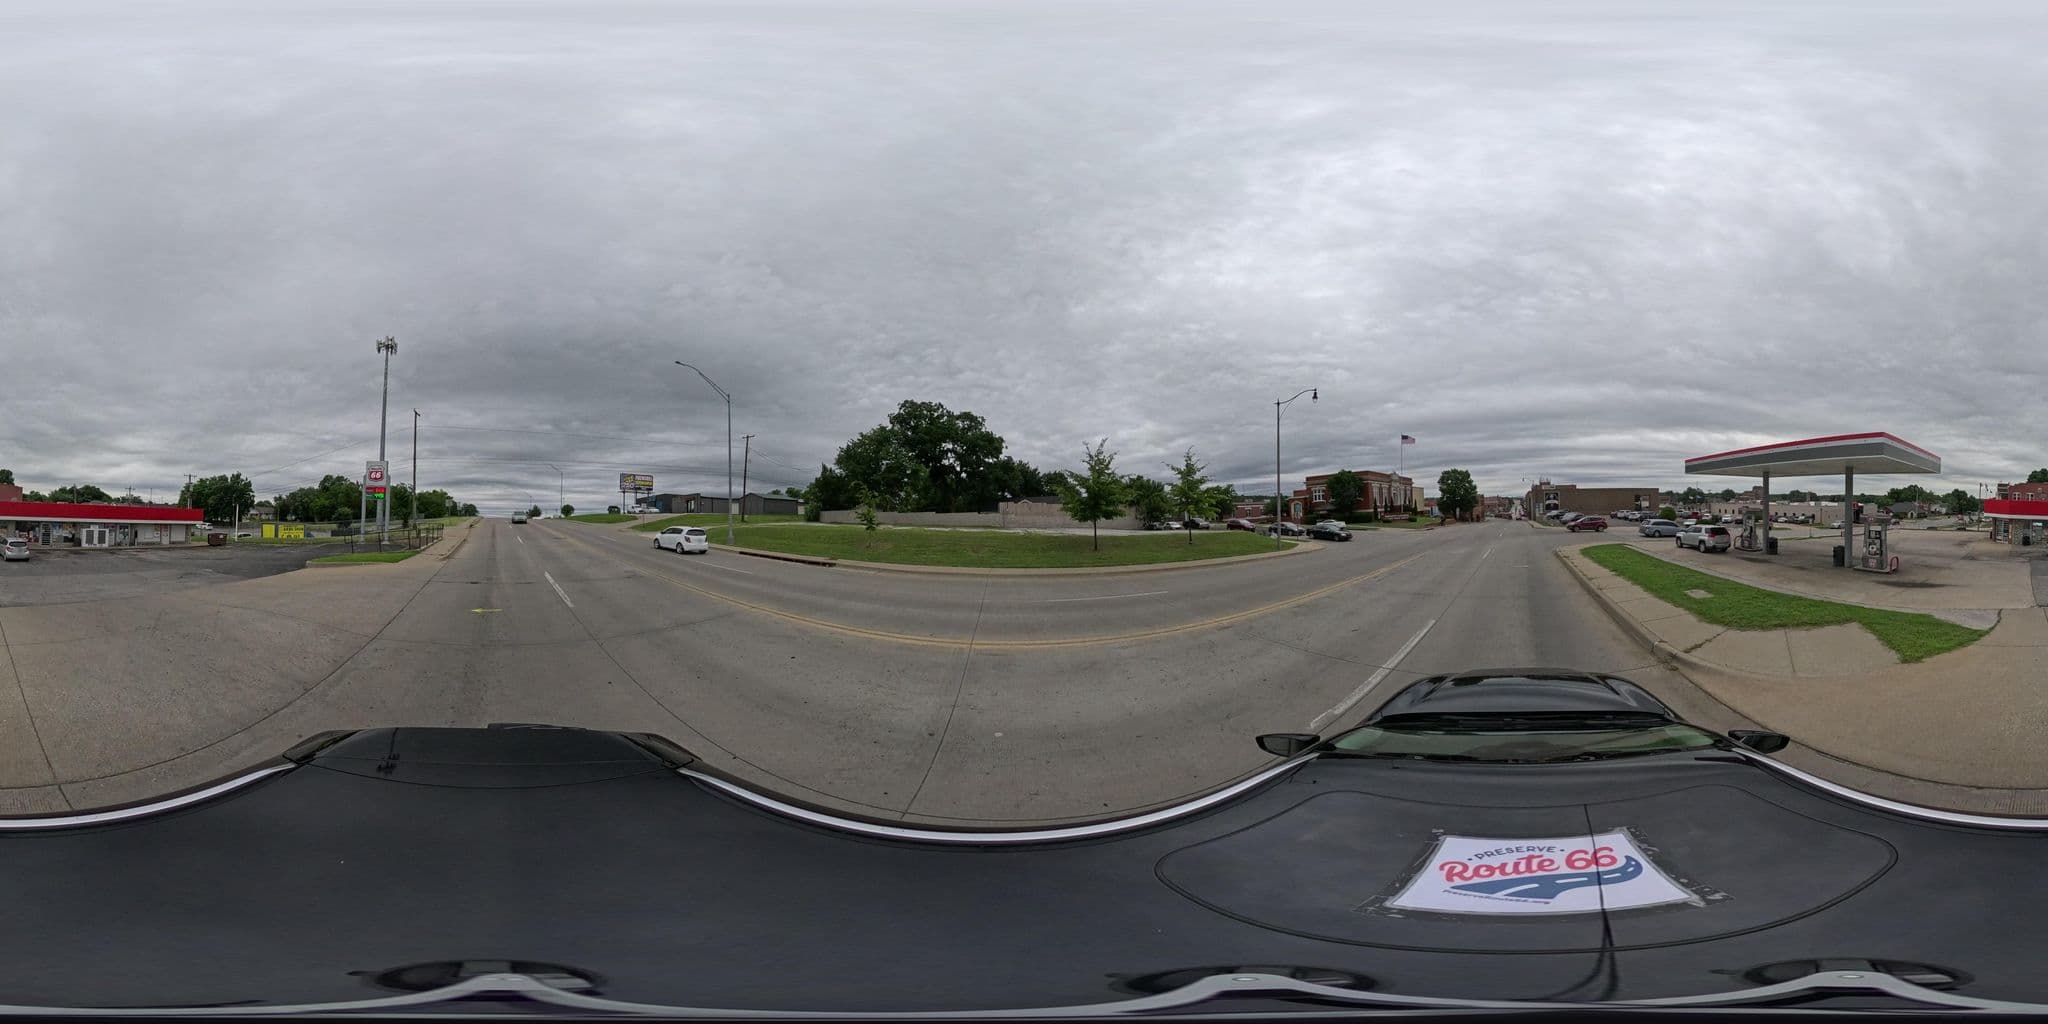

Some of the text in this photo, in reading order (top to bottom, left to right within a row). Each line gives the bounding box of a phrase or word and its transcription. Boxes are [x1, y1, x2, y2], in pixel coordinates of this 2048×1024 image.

[370, 471, 381, 479] 66
[1474, 845, 1557, 860] PRESERVE
[1439, 846, 1618, 883] Route 66
